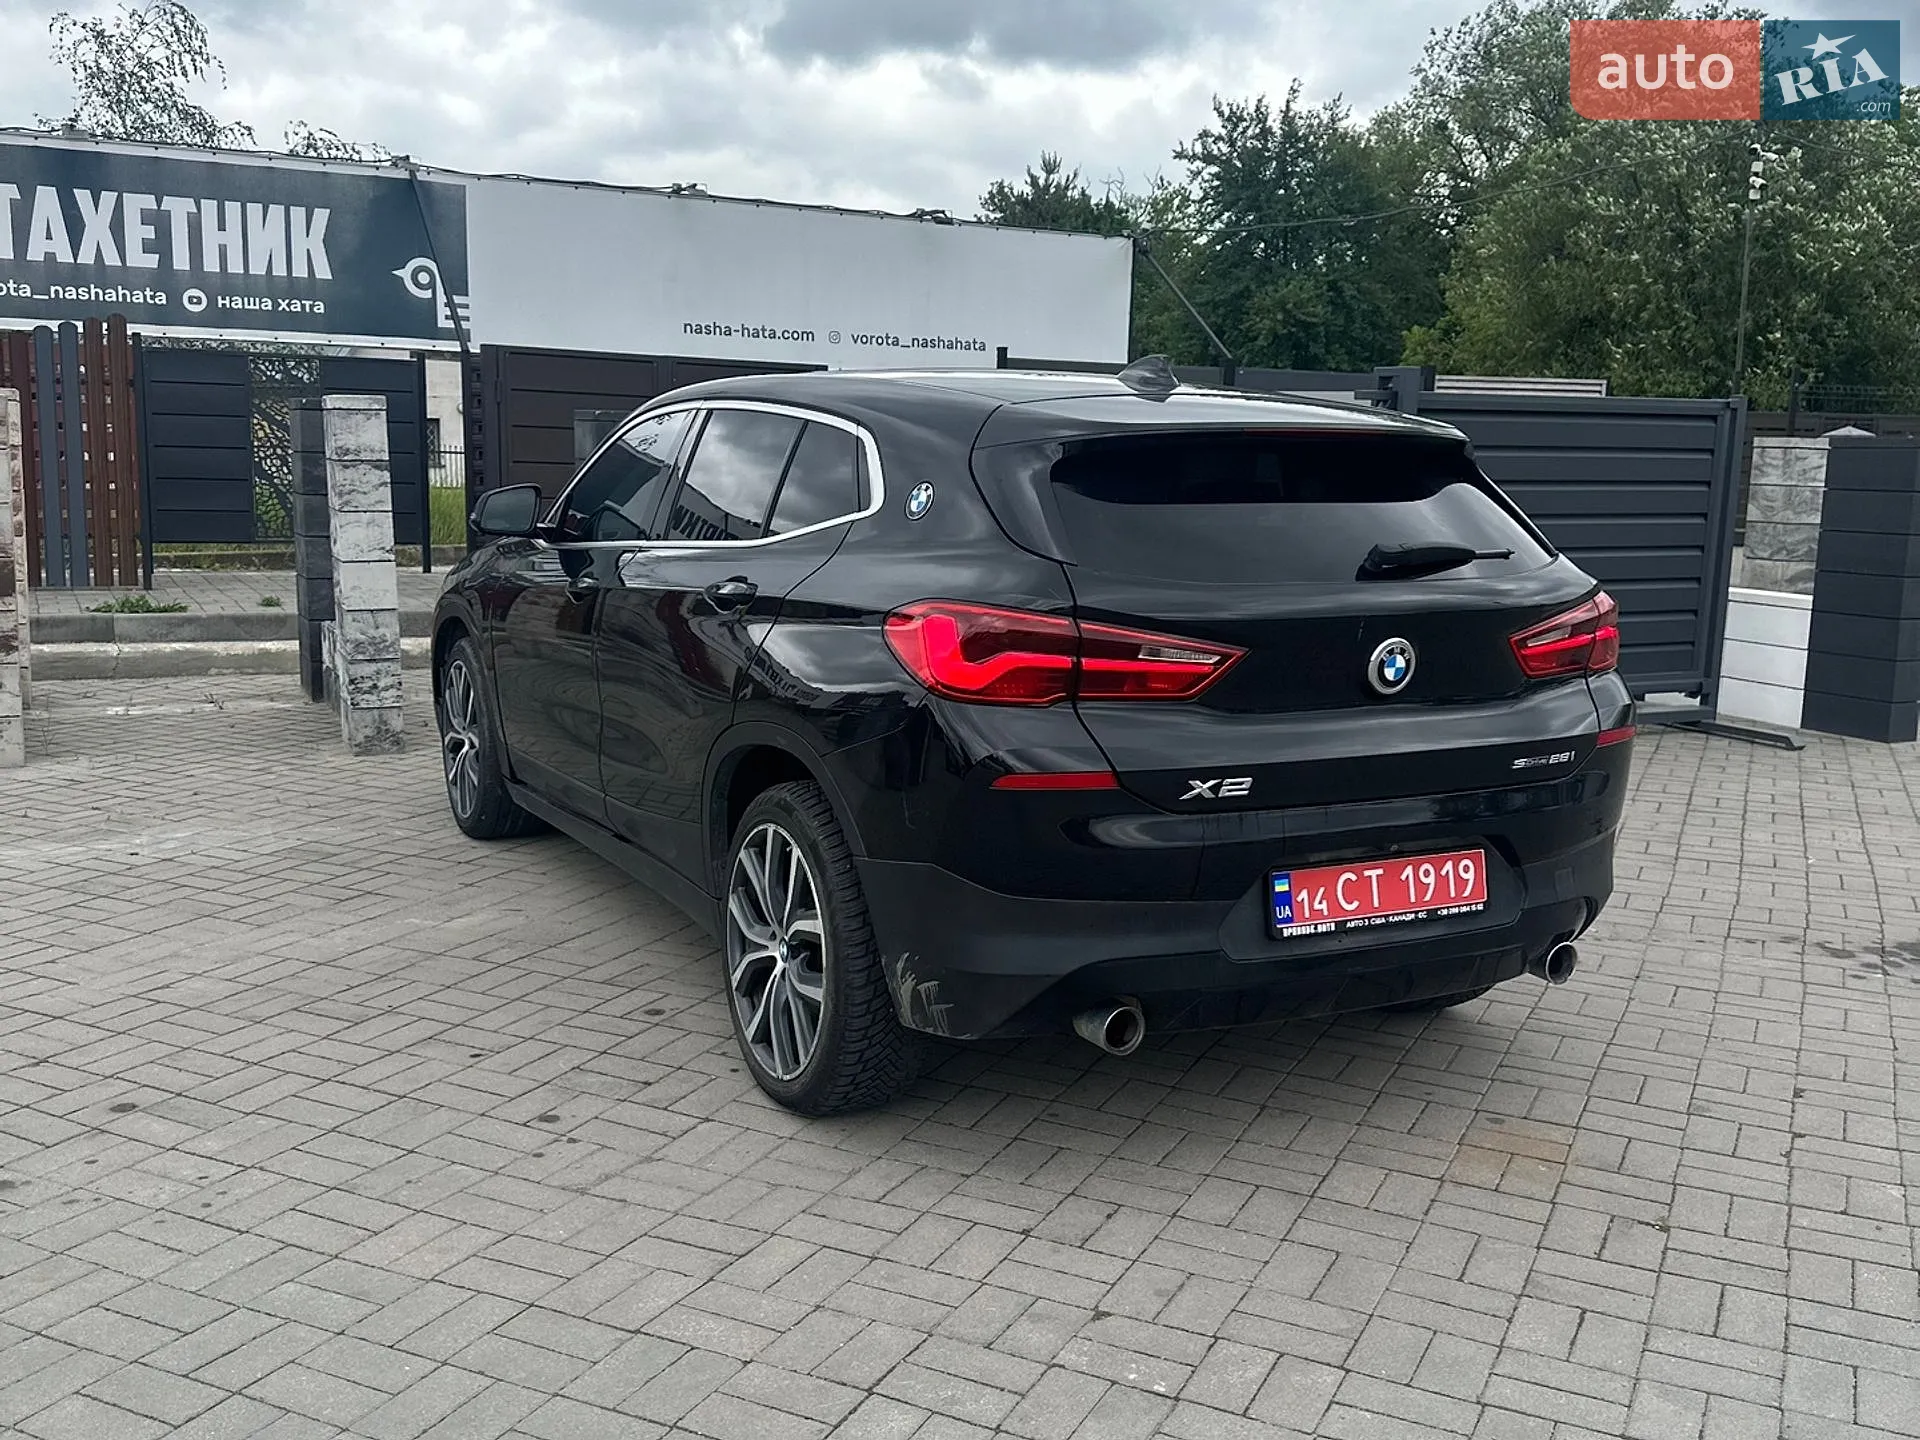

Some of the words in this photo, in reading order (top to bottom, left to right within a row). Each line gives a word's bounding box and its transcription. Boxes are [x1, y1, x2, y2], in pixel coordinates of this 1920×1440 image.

[217, 295, 273, 311] наша
[277, 298, 325, 313] хата
[683, 320, 815, 342] nasha-hata.com
[851, 332, 987, 352] vorota_nashahata
[1179, 776, 1254, 800] X2
[1296, 886, 1330, 919] 14
[1400, 858, 1476, 903] 1919
[1276, 905, 1292, 919] UA
